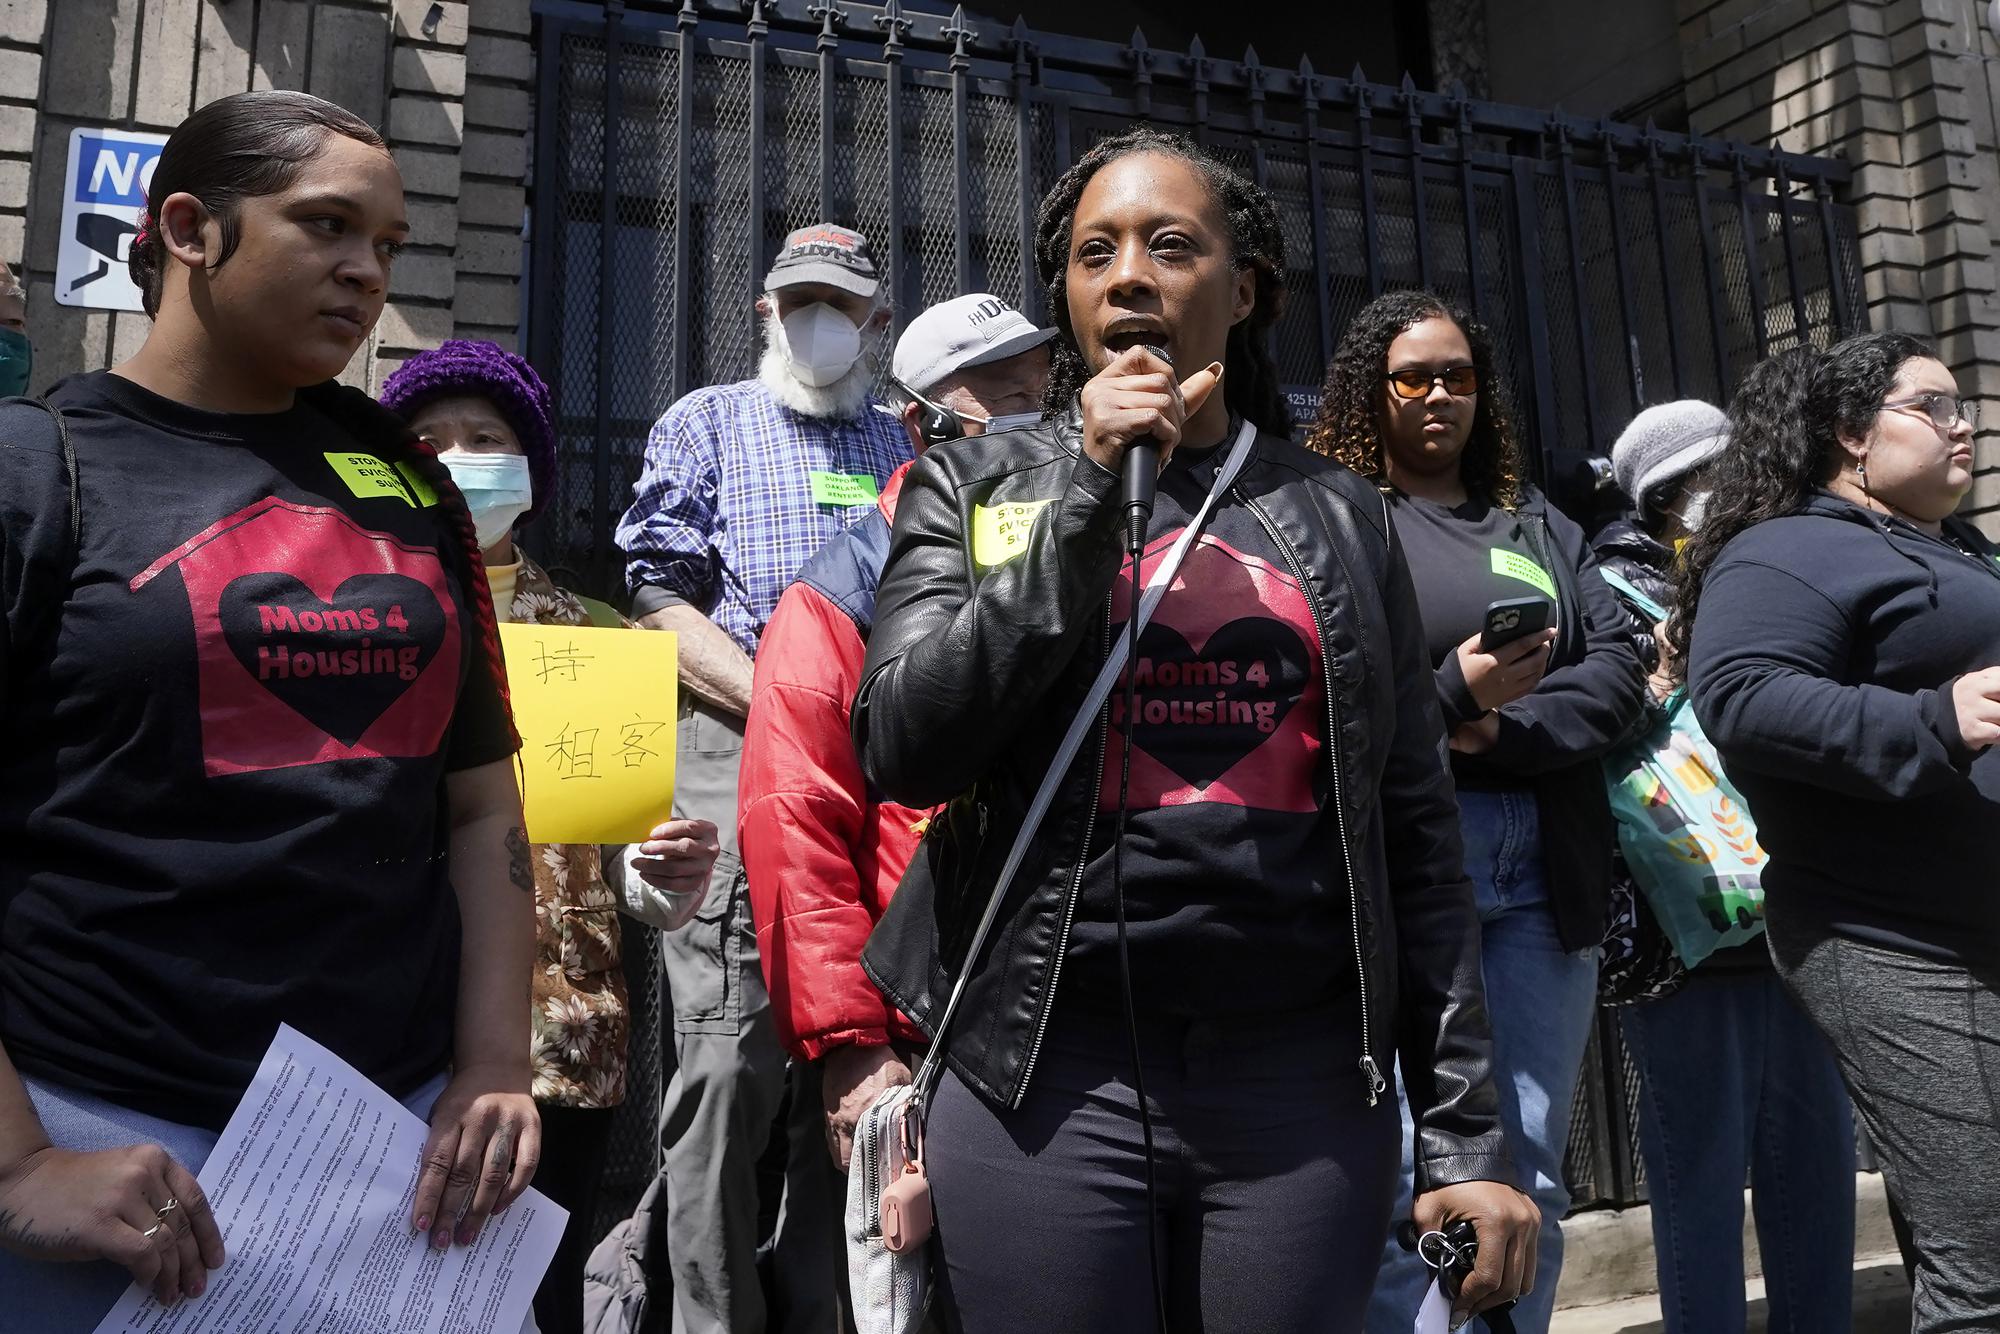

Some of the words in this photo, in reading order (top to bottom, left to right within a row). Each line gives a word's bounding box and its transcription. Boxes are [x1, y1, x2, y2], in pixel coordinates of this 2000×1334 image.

[347, 457, 378, 466] STOP
[825, 475, 859, 483] SUPPORT
[825, 483, 864, 491] OAKLAND
[998, 507, 1034, 519] STOP
[999, 519, 1033, 534] EVIC
[258, 605, 380, 634] Moms
[385, 604, 409, 633] 4
[258, 638, 421, 681] Housing
[532, 640, 595, 684] 持
[1118, 657, 1239, 688] Moms
[1245, 660, 1270, 688] 4
[1112, 691, 1277, 734] Housing
[212, 1177, 233, 1209] exceeding
[229, 1136, 256, 1178] pre-pandemic
[252, 1118, 265, 1136] levels
[279, 1064, 295, 1088] counties
[217, 1149, 241, 1187] proceedings
[238, 1134, 248, 1149] after
[249, 1109, 263, 1129] nearly
[274, 1051, 294, 1083] moratorium
[238, 1170, 260, 1206] responsible
[257, 1141, 275, 1168] transition
[285, 1089, 304, 1118] Oakland's
[302, 1065, 316, 1087] eviction
[196, 1277, 223, 1313] moratorium
[222, 1258, 237, 1276] could
[236, 1236, 249, 1256] create
[291, 1134, 302, 1149] seen
[304, 1108, 316, 1124] other
[304, 1197, 322, 1227] exception
[325, 1156, 342, 1182] Alameda
[213, 1287, 243, 1327] responsibility
[247, 1254, 263, 1277] sunset
[267, 1206, 287, 1241] moratorium
[290, 1180, 301, 1194] City
[309, 1140, 321, 1156] must
[318, 1122, 331, 1139] make
[247, 1297, 260, 1313] state
[287, 1230, 298, 1246] Area
[295, 1203, 311, 1230] Evictions
[308, 1181, 321, 1203] soared
[322, 1144, 342, 1174] pandemic
[284, 1266, 310, 1307] consideration
[354, 1144, 369, 1169] Oakland
[324, 1238, 345, 1273] September
[215, 1275, 235, 1299] already
[227, 1302, 242, 1320] many
[239, 1269, 262, 1301] vulnerable
[259, 1247, 274, 1269] renters
